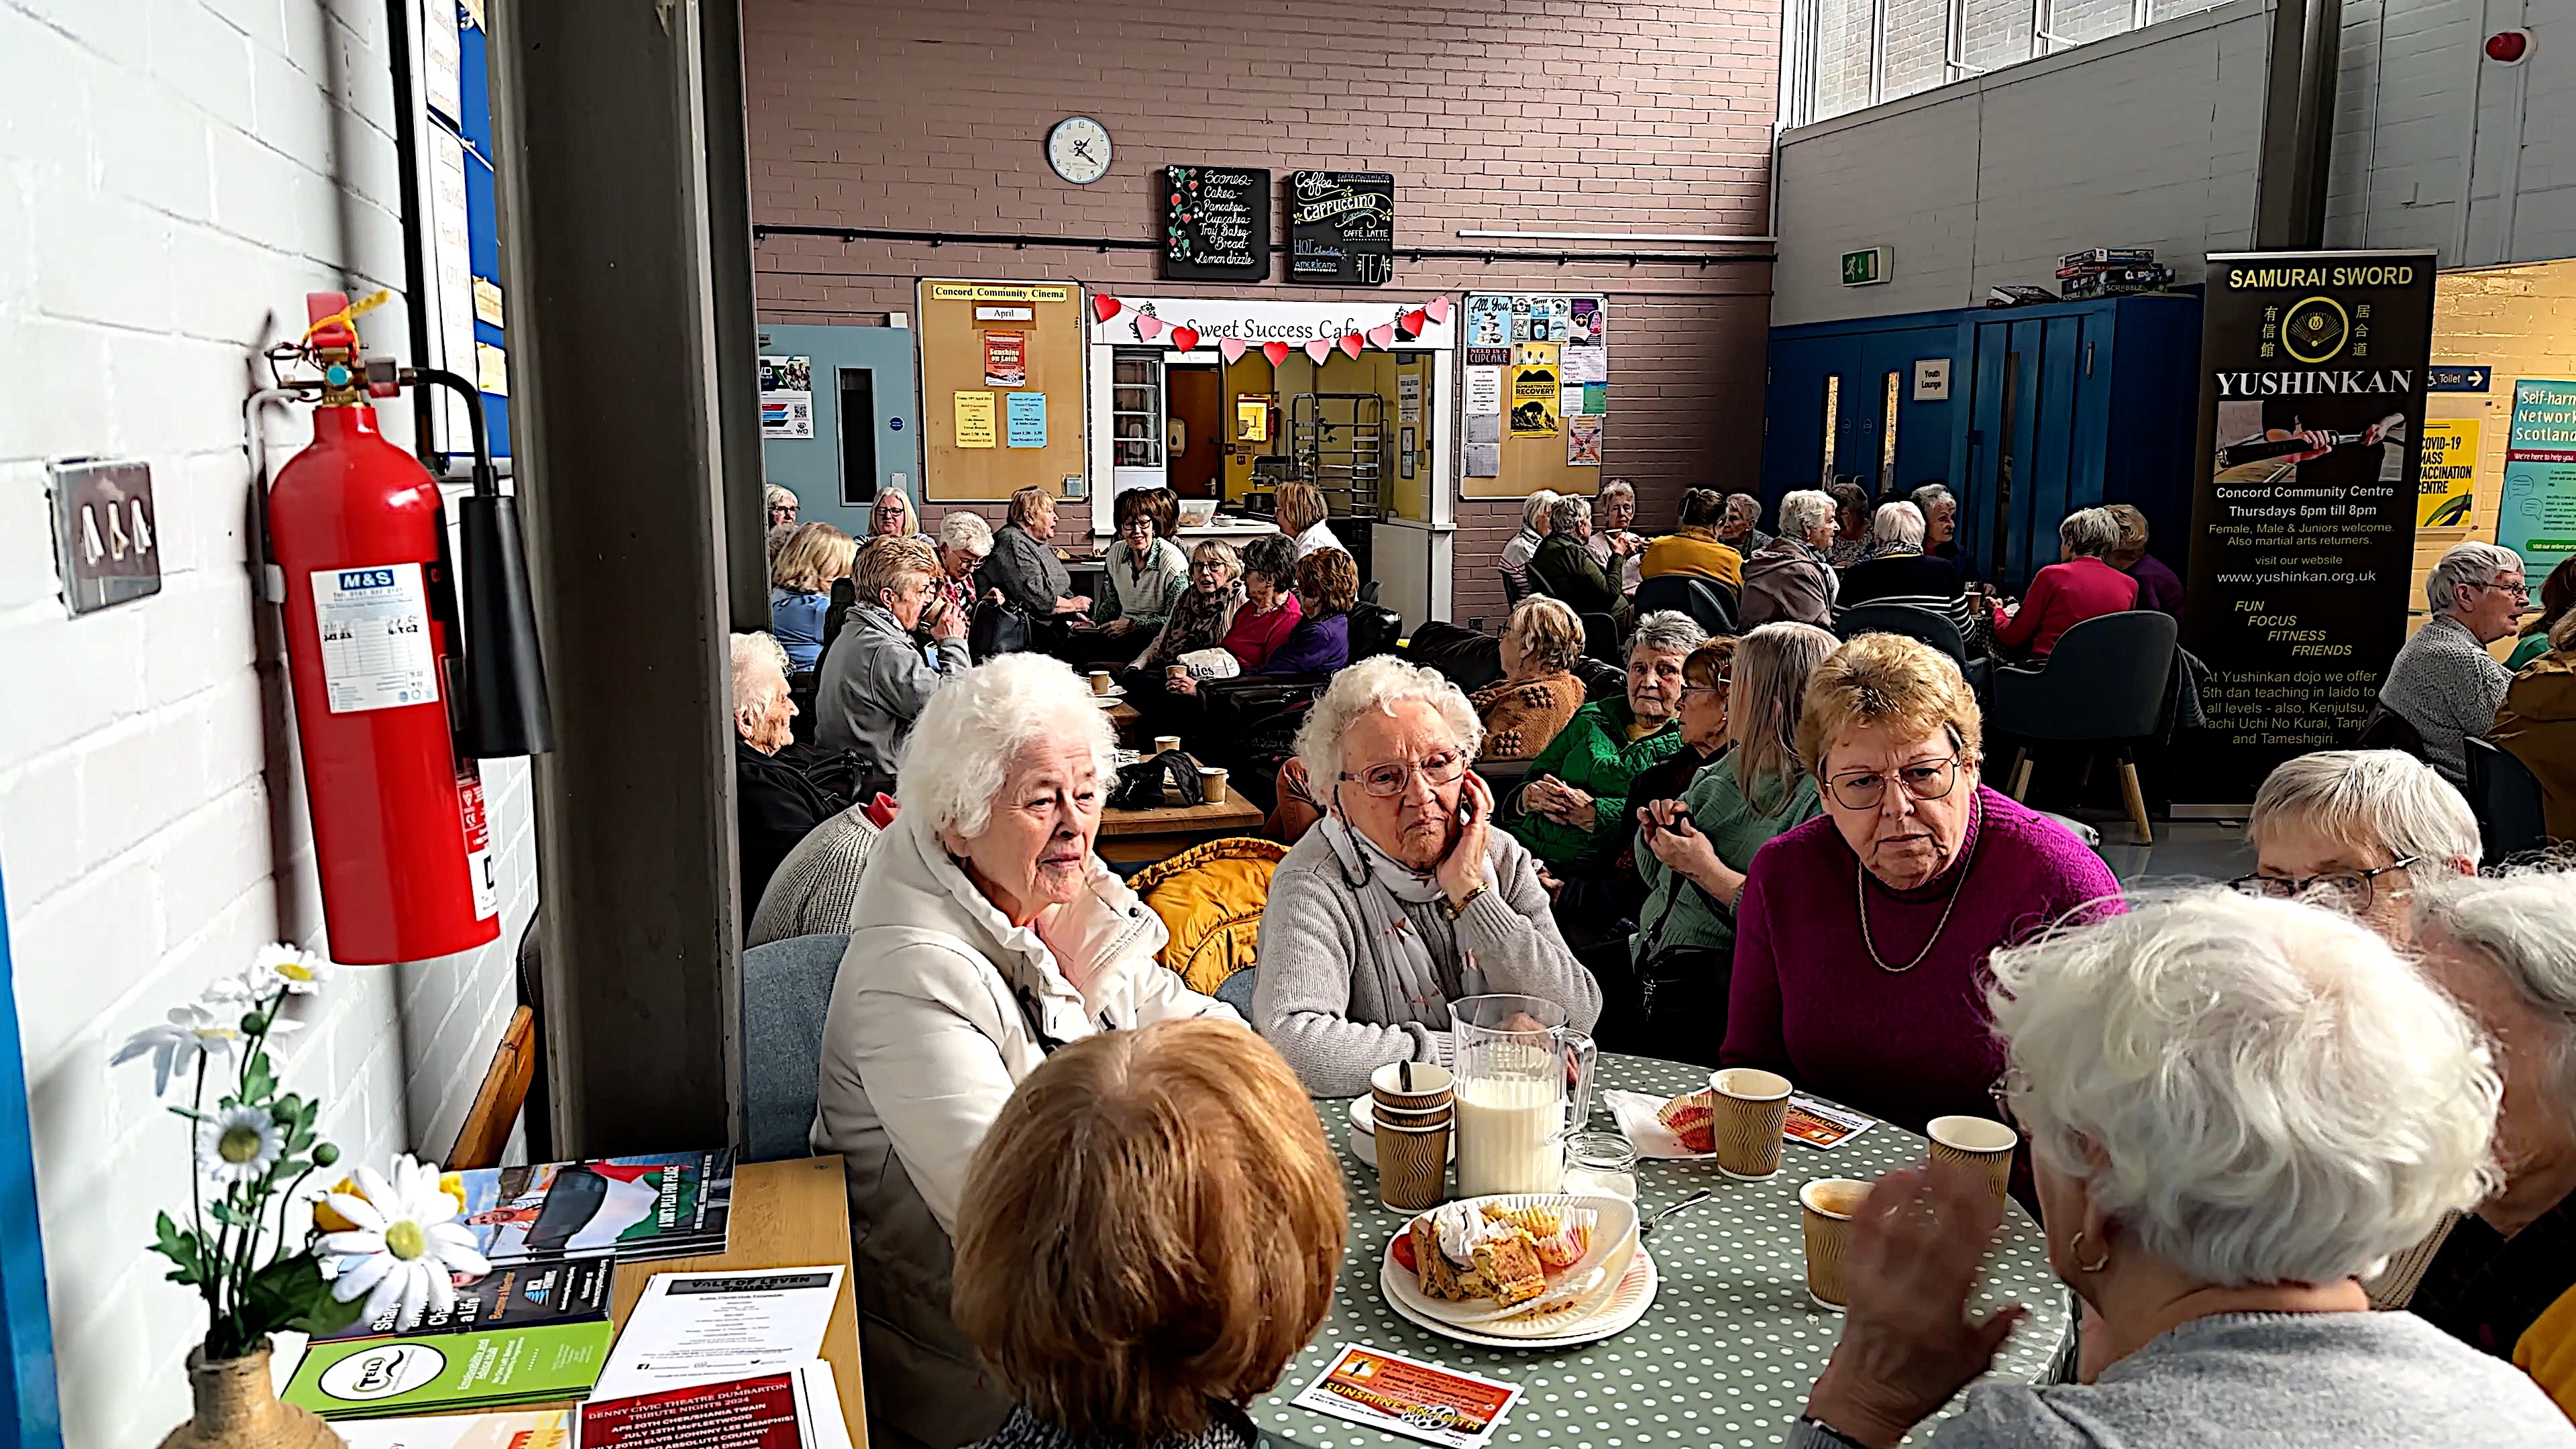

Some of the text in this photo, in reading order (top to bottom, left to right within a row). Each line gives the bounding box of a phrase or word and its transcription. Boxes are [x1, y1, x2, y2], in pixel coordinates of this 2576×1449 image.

[1295, 170, 1339, 196] Coffee
[1199, 222, 1218, 244] Tray
[1294, 239, 1314, 254] HOT
[1195, 251, 1226, 264] Lemon
[1358, 254, 1388, 283] TEA
[2229, 266, 2413, 288] SAMURAI SWORD
[935, 287, 1065, 299] Concord Community Cinema
[2106, 284, 2143, 292] SCRABBLE
[1471, 297, 1489, 313] All
[1491, 297, 1509, 312] You
[994, 309, 1014, 319] April
[1244, 319, 1313, 339] Success
[2260, 305, 2278, 358] 有信館
[2353, 304, 2371, 357] 居合道
[989, 348, 1020, 356] Sunshine
[1470, 353, 1507, 363] CUPCAKE
[1925, 370, 1941, 378] Youth
[2439, 374, 2461, 384] Toilet
[1921, 380, 1941, 390] Lounge
[2216, 370, 2414, 396] YUSHINKAN
[2216, 486, 2394, 500] Concord Community Centre
[2229, 505, 2296, 519] Thursdays
[2330, 505, 2345, 516] till
[2349, 505, 2377, 517] 8pm
[2209, 523, 2395, 535] Female, Male & Juniors welcome.
[2227, 536, 2373, 546] Also martial arts returners.
[2255, 556, 2277, 566] visit
[2302, 555, 2343, 565] website
[2217, 570, 2377, 585] www.yushinkan.org.uk
[2235, 601, 2265, 611] FUN
[2247, 615, 2297, 627] FOCUS
[2267, 630, 2327, 642] FITNESS
[2292, 645, 2353, 656] FRIENDS
[2222, 671, 2290, 683] Yushinkan
[2294, 672, 2321, 685] dojo
[2325, 674, 2343, 682] we
[2347, 671, 2377, 682] offer
[2202, 687, 2222, 698] 5th
[2226, 687, 2250, 698] dan
[2255, 687, 2309, 700] teaching
[2313, 688, 2324, 697] in
[2363, 688, 2375, 697] to
[2207, 702, 2369, 716] all levels also, Kenjutsu,
[2239, 718, 2267, 729] Uchi
[2271, 718, 2290, 729] No
[2294, 717, 2330, 730] Kurai,
[2233, 734, 2256, 745] and
[663, 1165, 680, 1182] PEACE
[661, 1183, 678, 1193] FOR
[660, 1194, 677, 1208] PLEA
[760, 1276, 810, 1285] LEVEN
[458, 1297, 481, 1322] a Life
[360, 1359, 383, 1388] TELL
[588, 1383, 788, 1420] DENNY CIVIC THEATRE DUMBARTON
[1324, 1381, 1404, 1408] SUNSHINE
[1432, 1413, 1481, 1431] LEITH
[629, 1397, 750, 1421] TRIBUTE NIGHTS 2024
[611, 1403, 767, 1434] APR 20TH CHER/SHANIA TWAIN
[621, 1430, 649, 1440] JULY
[644, 1434, 673, 1445] ELVIS
[723, 1424, 742, 1433] LEE
[664, 1428, 769, 1449] ABSOLUTE COUNTRY
[721, 1438, 759, 1449] DREAM
